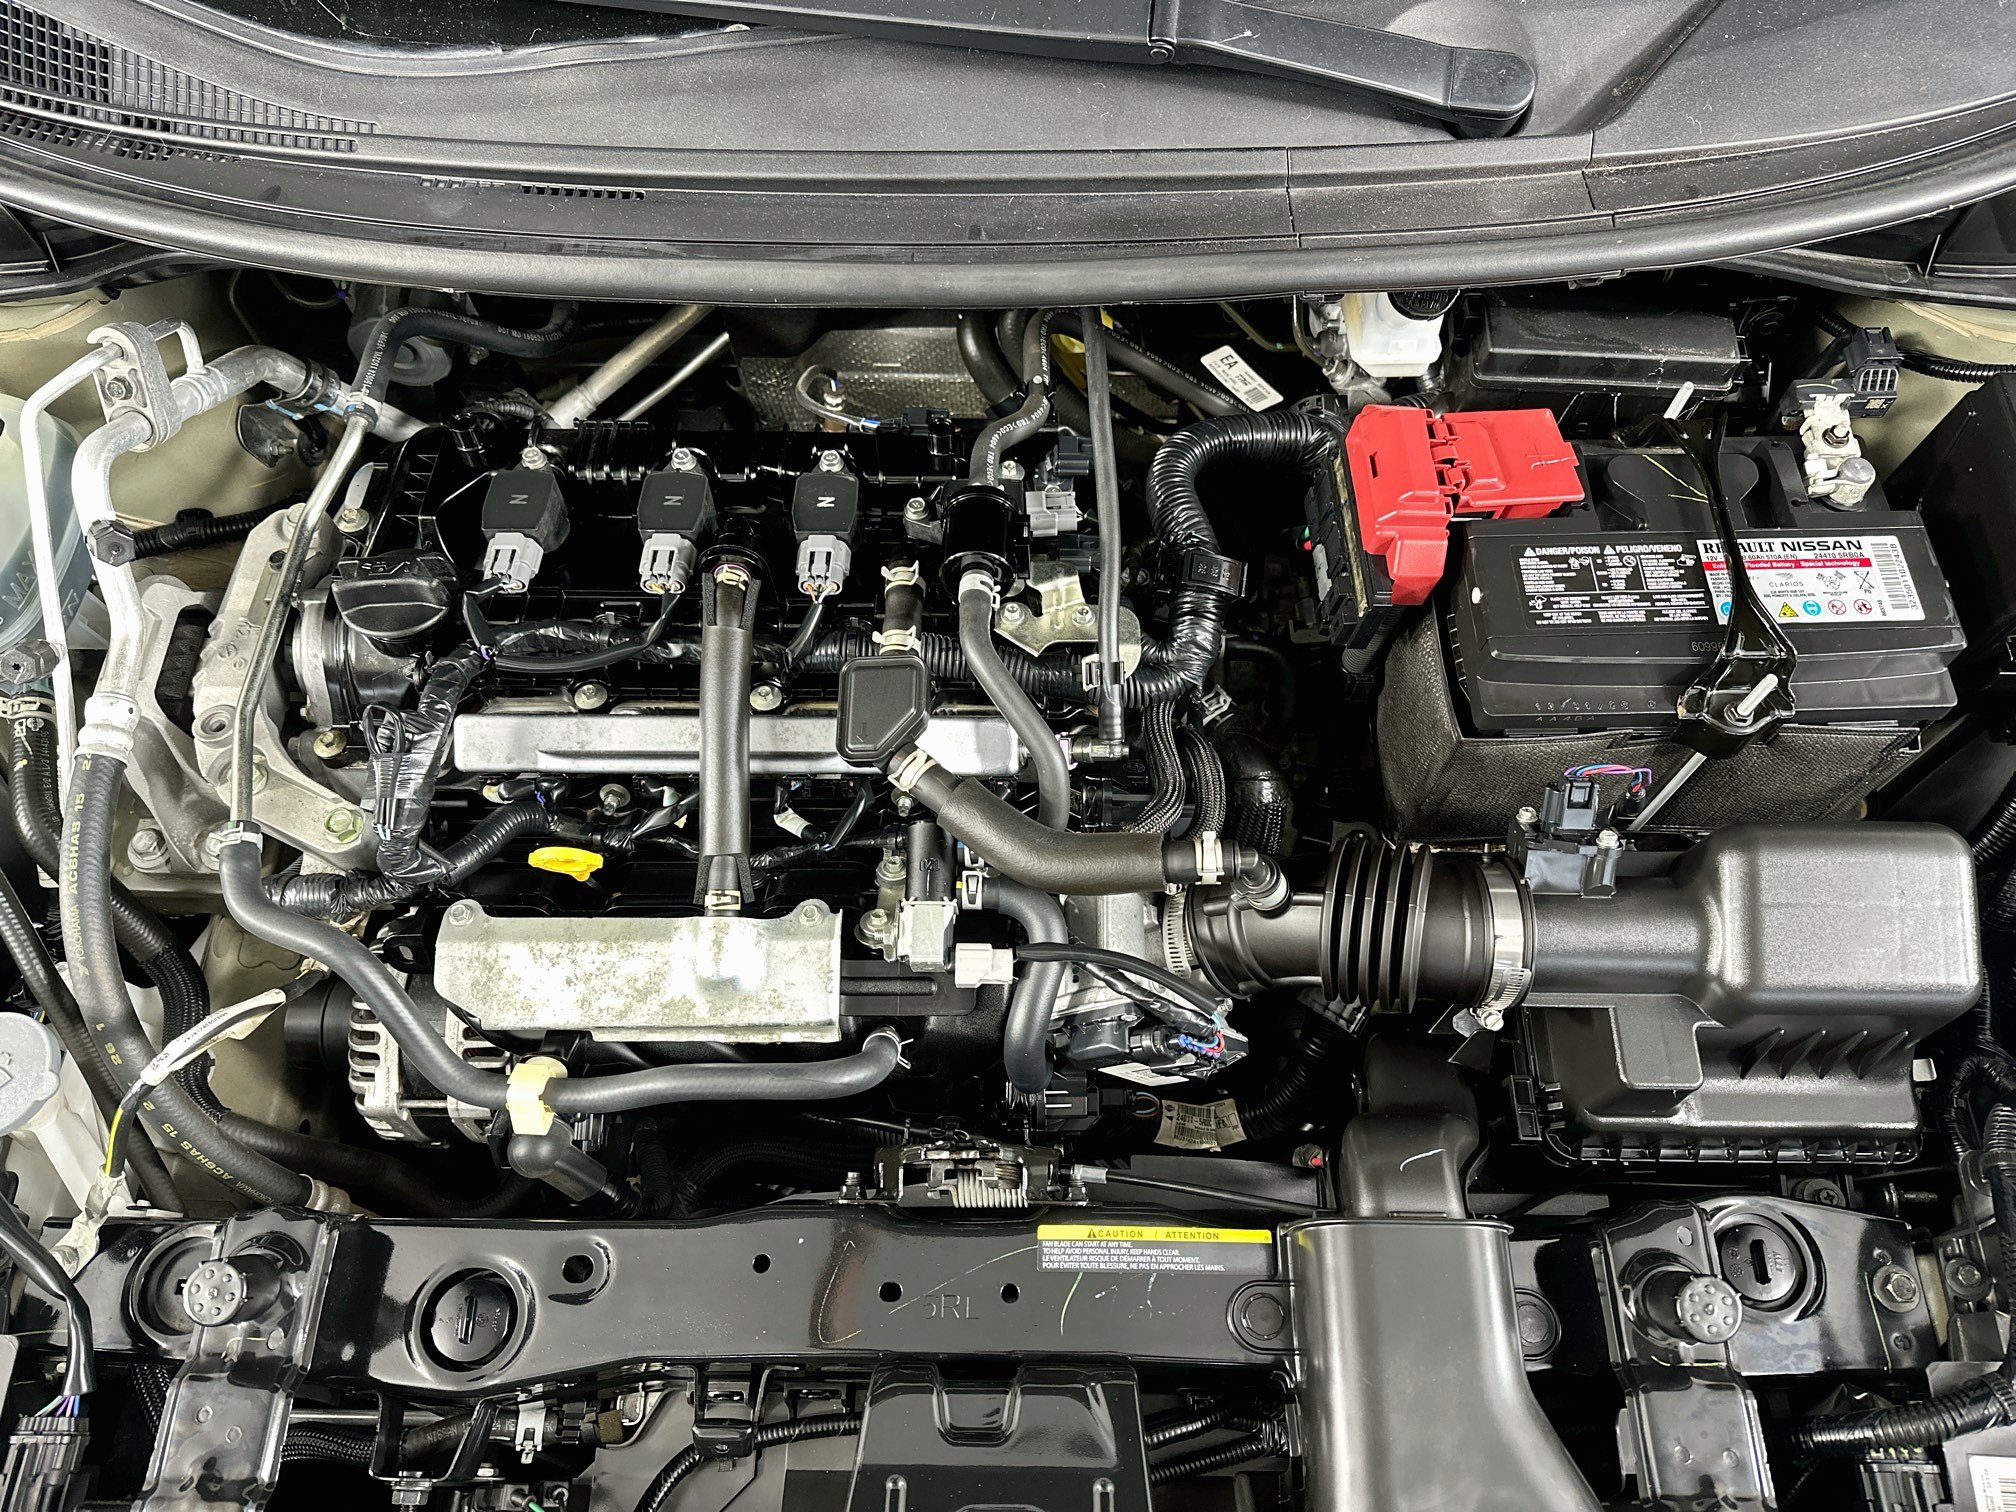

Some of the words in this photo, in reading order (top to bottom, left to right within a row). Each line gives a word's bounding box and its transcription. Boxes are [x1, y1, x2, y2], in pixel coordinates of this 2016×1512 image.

[1220, 354, 1239, 371] EA
[1535, 546, 1600, 556] DANGER/POISON
[1615, 544, 1683, 554] PELIGRO/VENENO
[1702, 541, 1775, 554] REAULT
[1780, 540, 1863, 552] NISSAN
[74, 792, 86, 812] 15
[72, 904, 86, 961] YOKOHAMA
[161, 1123, 179, 1139] 15
[1098, 1230, 1143, 1238] CAUTION
[1165, 1231, 1219, 1240] ATTENTION
[1110, 1248, 1129, 1256] INJURY,
[1089, 1255, 1111, 1263] RISQUE
[1119, 1254, 1151, 1263] DÉMARRER
[1172, 1256, 1201, 1264] MOMENT.
[1060, 1261, 1080, 1269] ÉVITER
[1099, 1262, 1130, 1270] BLESSURE,
[1205, 1264, 1226, 1272] MAINS.
[426, 1424, 458, 1444] NISSAN
